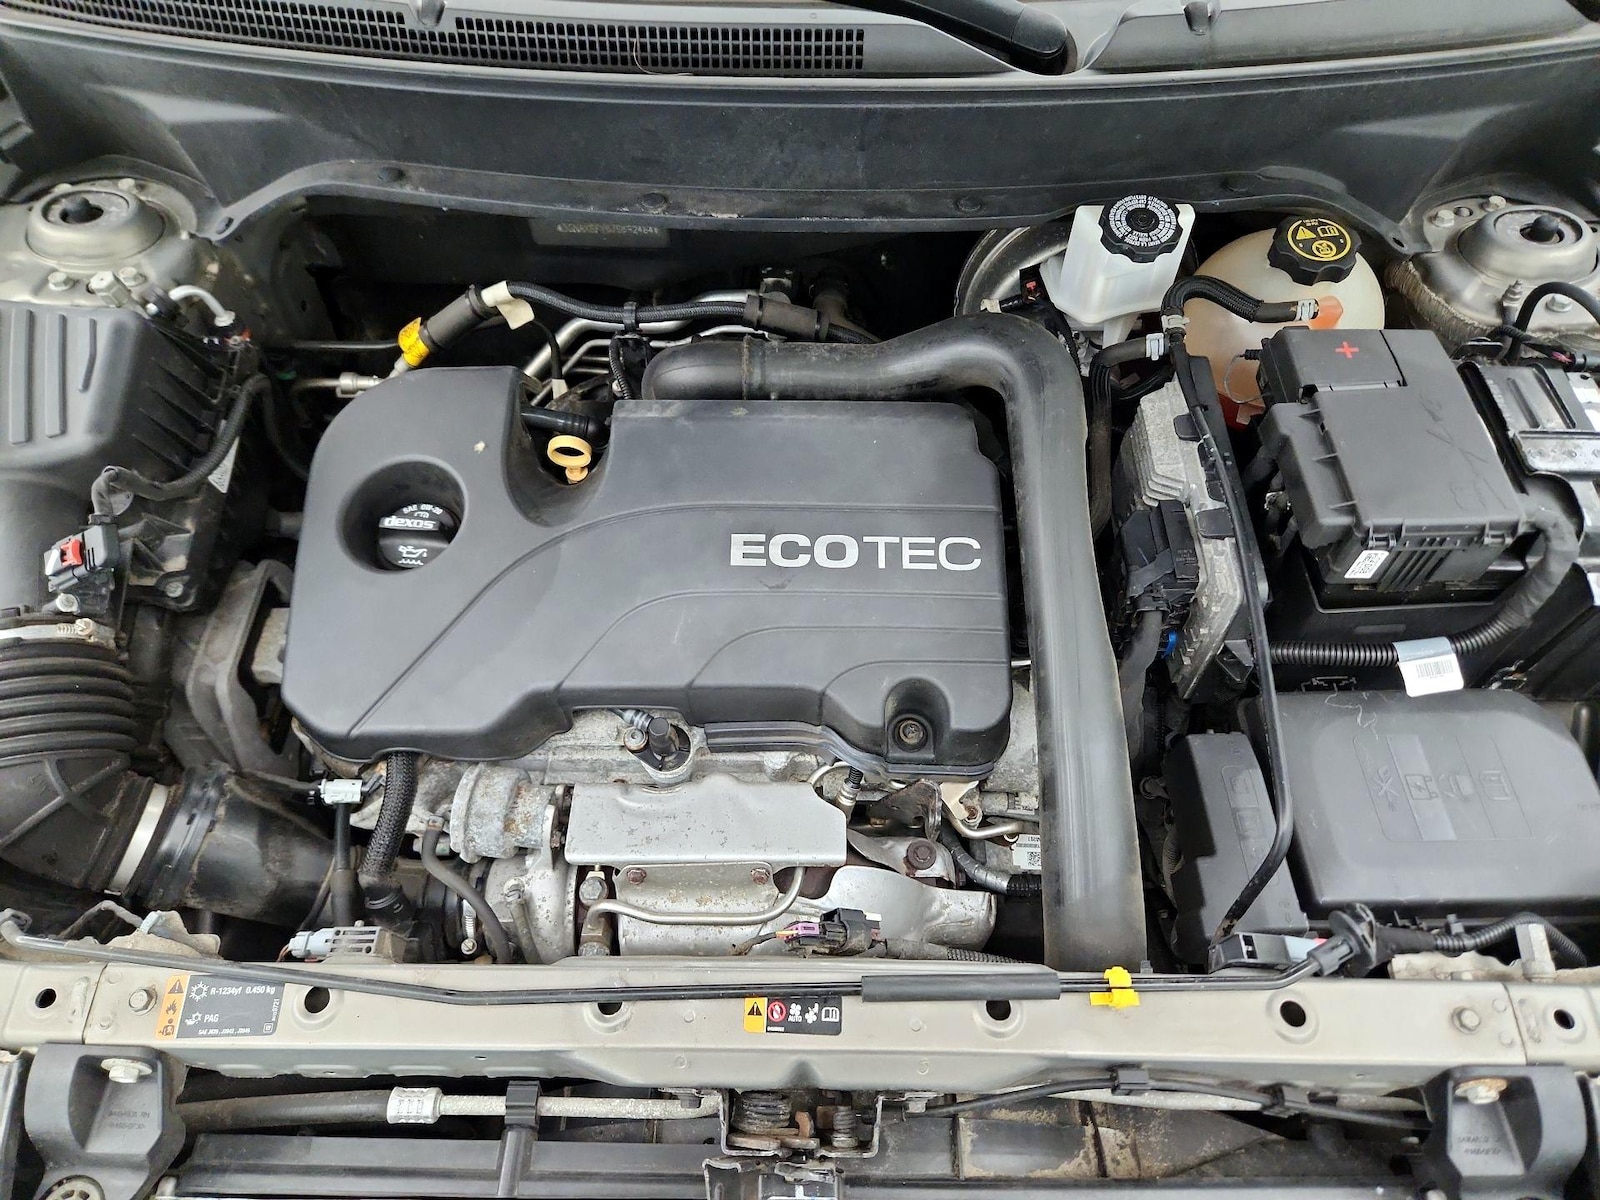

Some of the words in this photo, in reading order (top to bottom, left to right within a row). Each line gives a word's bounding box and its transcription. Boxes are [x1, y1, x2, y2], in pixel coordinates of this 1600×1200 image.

[402, 504, 418, 514] SAE
[420, 504, 444, 515] 0W-20
[384, 515, 437, 529] dexos
[730, 533, 982, 571] ECOTEC
[210, 986, 243, 996] R-1234yf
[246, 986, 266, 994] 0.450
[266, 985, 276, 995] kg
[203, 1013, 220, 1023] PAG
